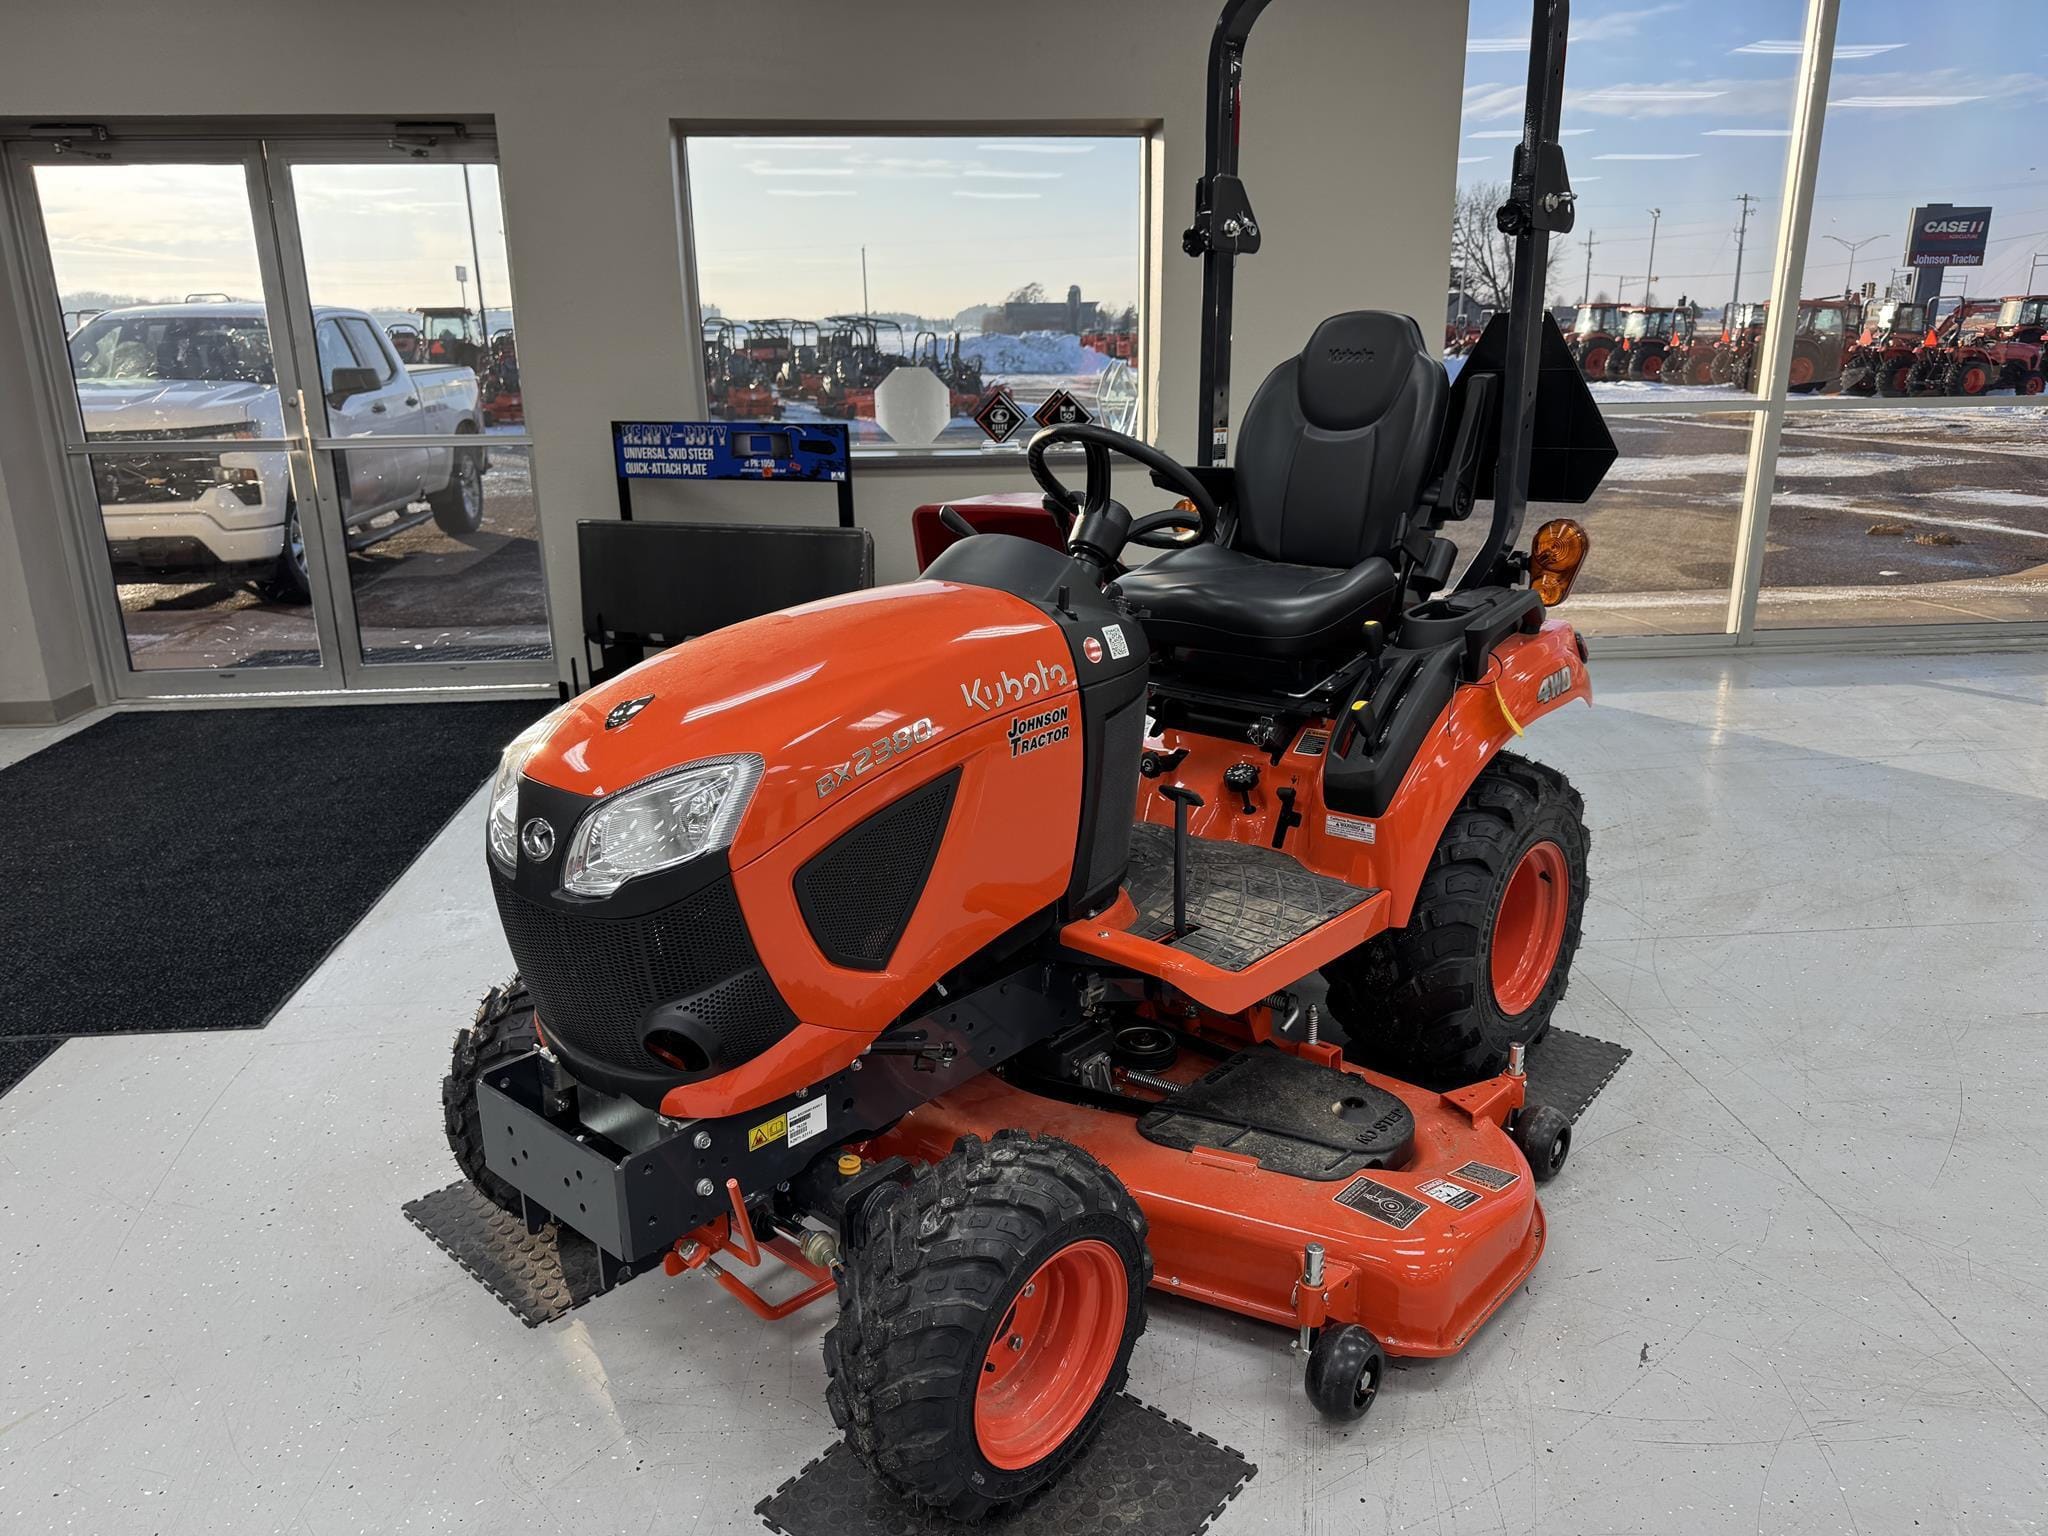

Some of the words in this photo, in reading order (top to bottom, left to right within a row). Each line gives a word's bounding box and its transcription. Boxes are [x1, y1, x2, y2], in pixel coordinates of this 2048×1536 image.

[1924, 221, 1970, 233] CASE
[1913, 254, 1950, 265] Johnson
[1952, 254, 1980, 265] Tractor
[623, 447, 667, 460] UNIVERSAL
[668, 448, 687, 460] SKID
[688, 448, 714, 460] STEER
[625, 462, 682, 475] QUICK-ATTACH
[683, 463, 708, 475] PLATE
[961, 660, 1068, 711] Kubota
[1537, 665, 1571, 704] 4WD
[1008, 706, 1069, 739] JOHNSON
[1010, 726, 1070, 757] TRACTOR
[816, 718, 933, 798] BX2380
[1356, 1131, 1377, 1146] NO
